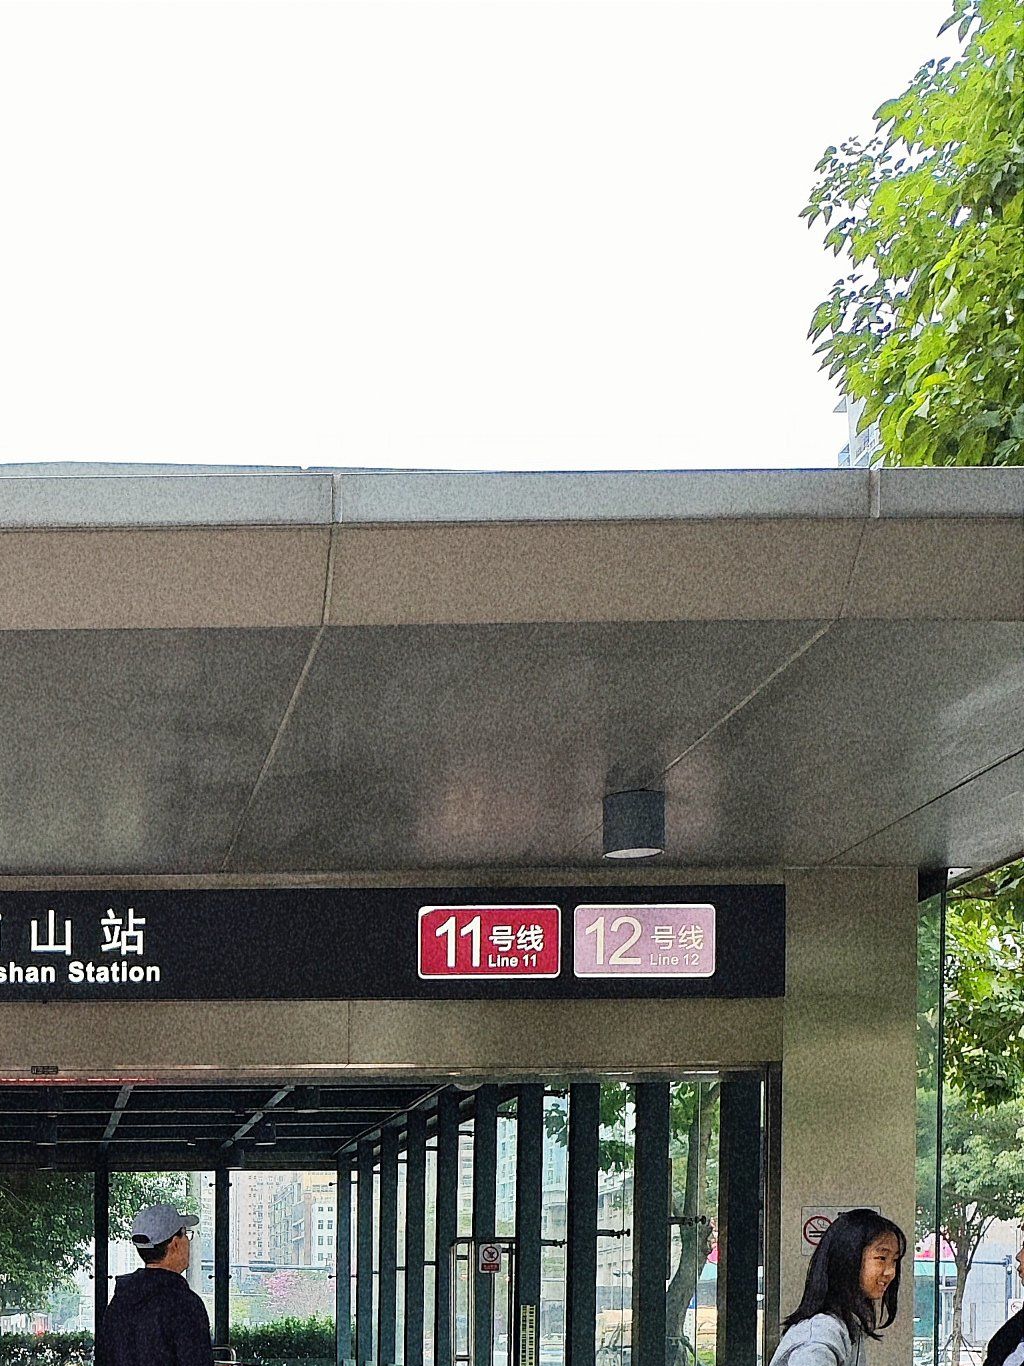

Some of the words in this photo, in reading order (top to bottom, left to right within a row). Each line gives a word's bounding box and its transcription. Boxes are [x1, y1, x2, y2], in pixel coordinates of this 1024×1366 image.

[488, 954, 518, 968] Line
[522, 954, 537, 967] 11
[650, 953, 679, 966] Line
[683, 953, 700, 966] 12
[68, 960, 161, 983] Station
